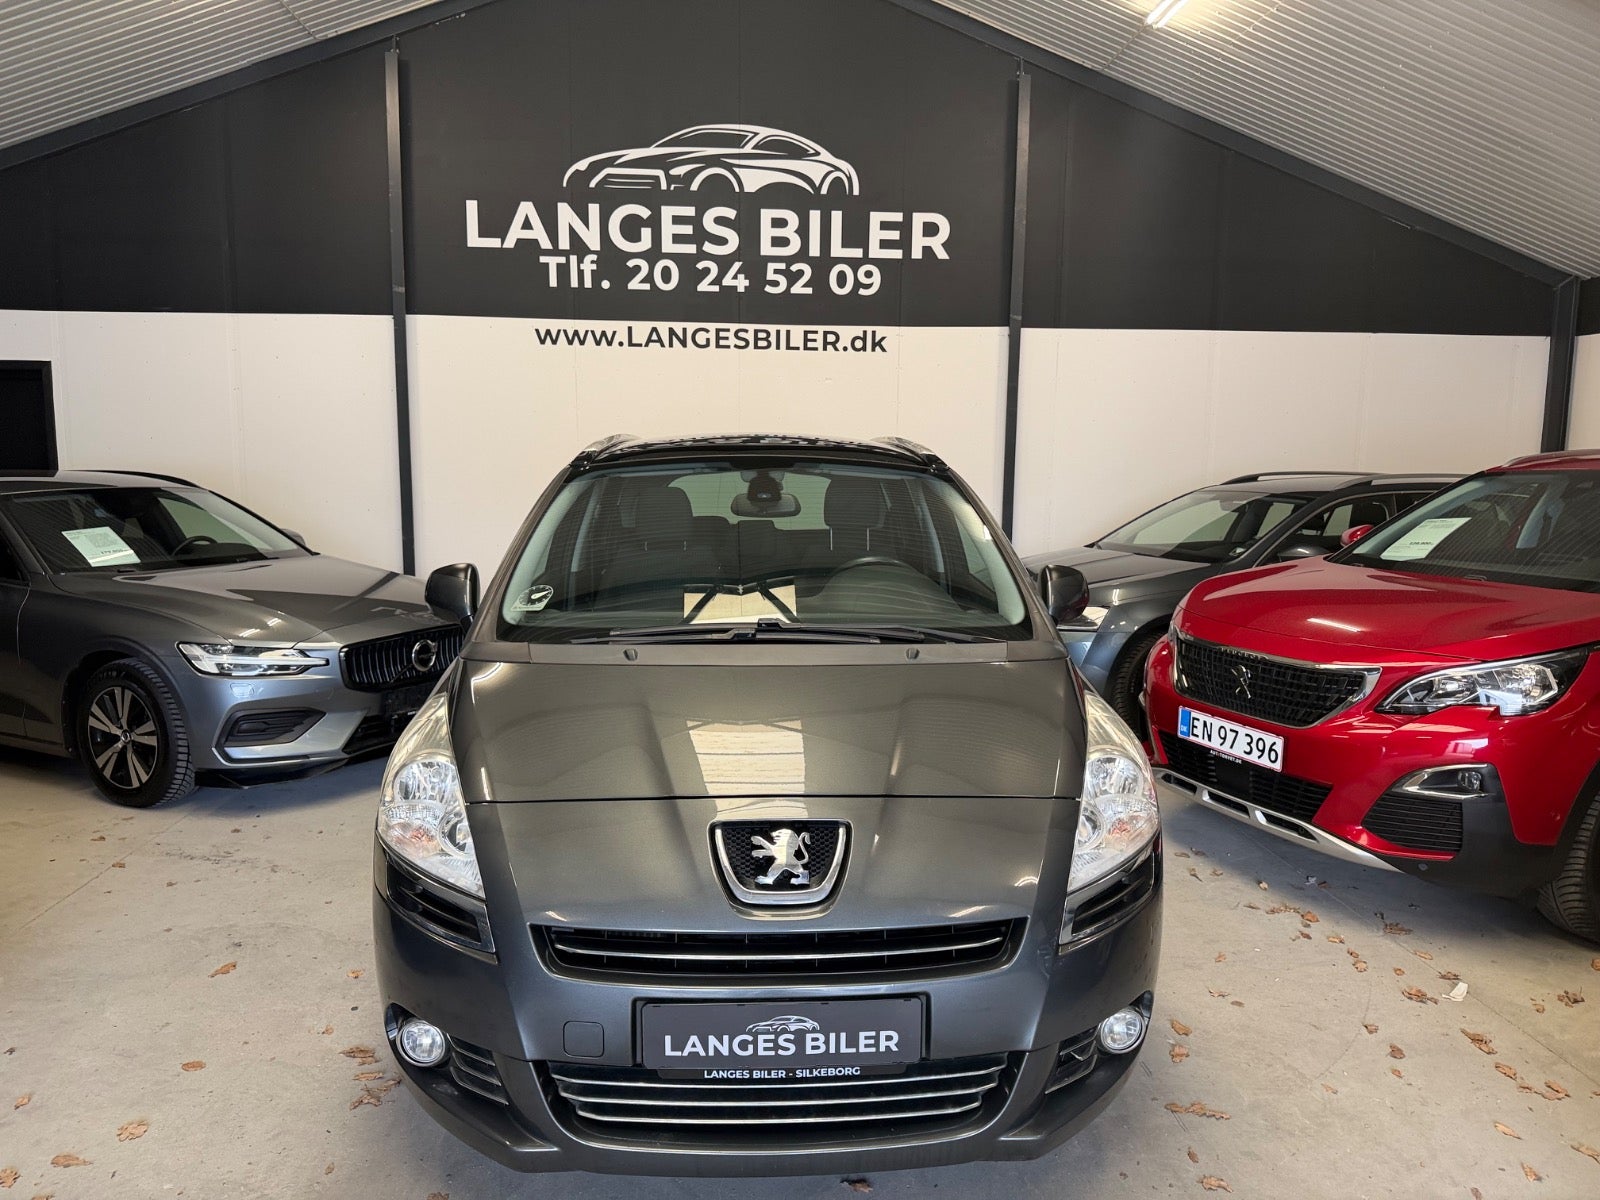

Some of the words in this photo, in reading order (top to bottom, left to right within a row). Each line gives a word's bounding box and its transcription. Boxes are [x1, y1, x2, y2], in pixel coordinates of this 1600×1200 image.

[465, 199, 740, 256] LANGES
[760, 208, 951, 260] BILER
[539, 253, 611, 290] Tlf.
[626, 258, 680, 291] 20
[695, 260, 750, 293] 24
[764, 262, 813, 294] 52
[829, 263, 882, 296] 09
[535, 325, 887, 353] www.LANGESBILER.dk
[1191, 716, 1213, 743] EN
[1217, 725, 1239, 750] 97
[1243, 733, 1279, 764] 396
[664, 1033, 796, 1057] LANGES
[805, 1030, 899, 1055] BILER
[703, 1069, 750, 1079] LANGES
[752, 1069, 786, 1079] BILER
[795, 1066, 861, 1078] SILKEBORG
